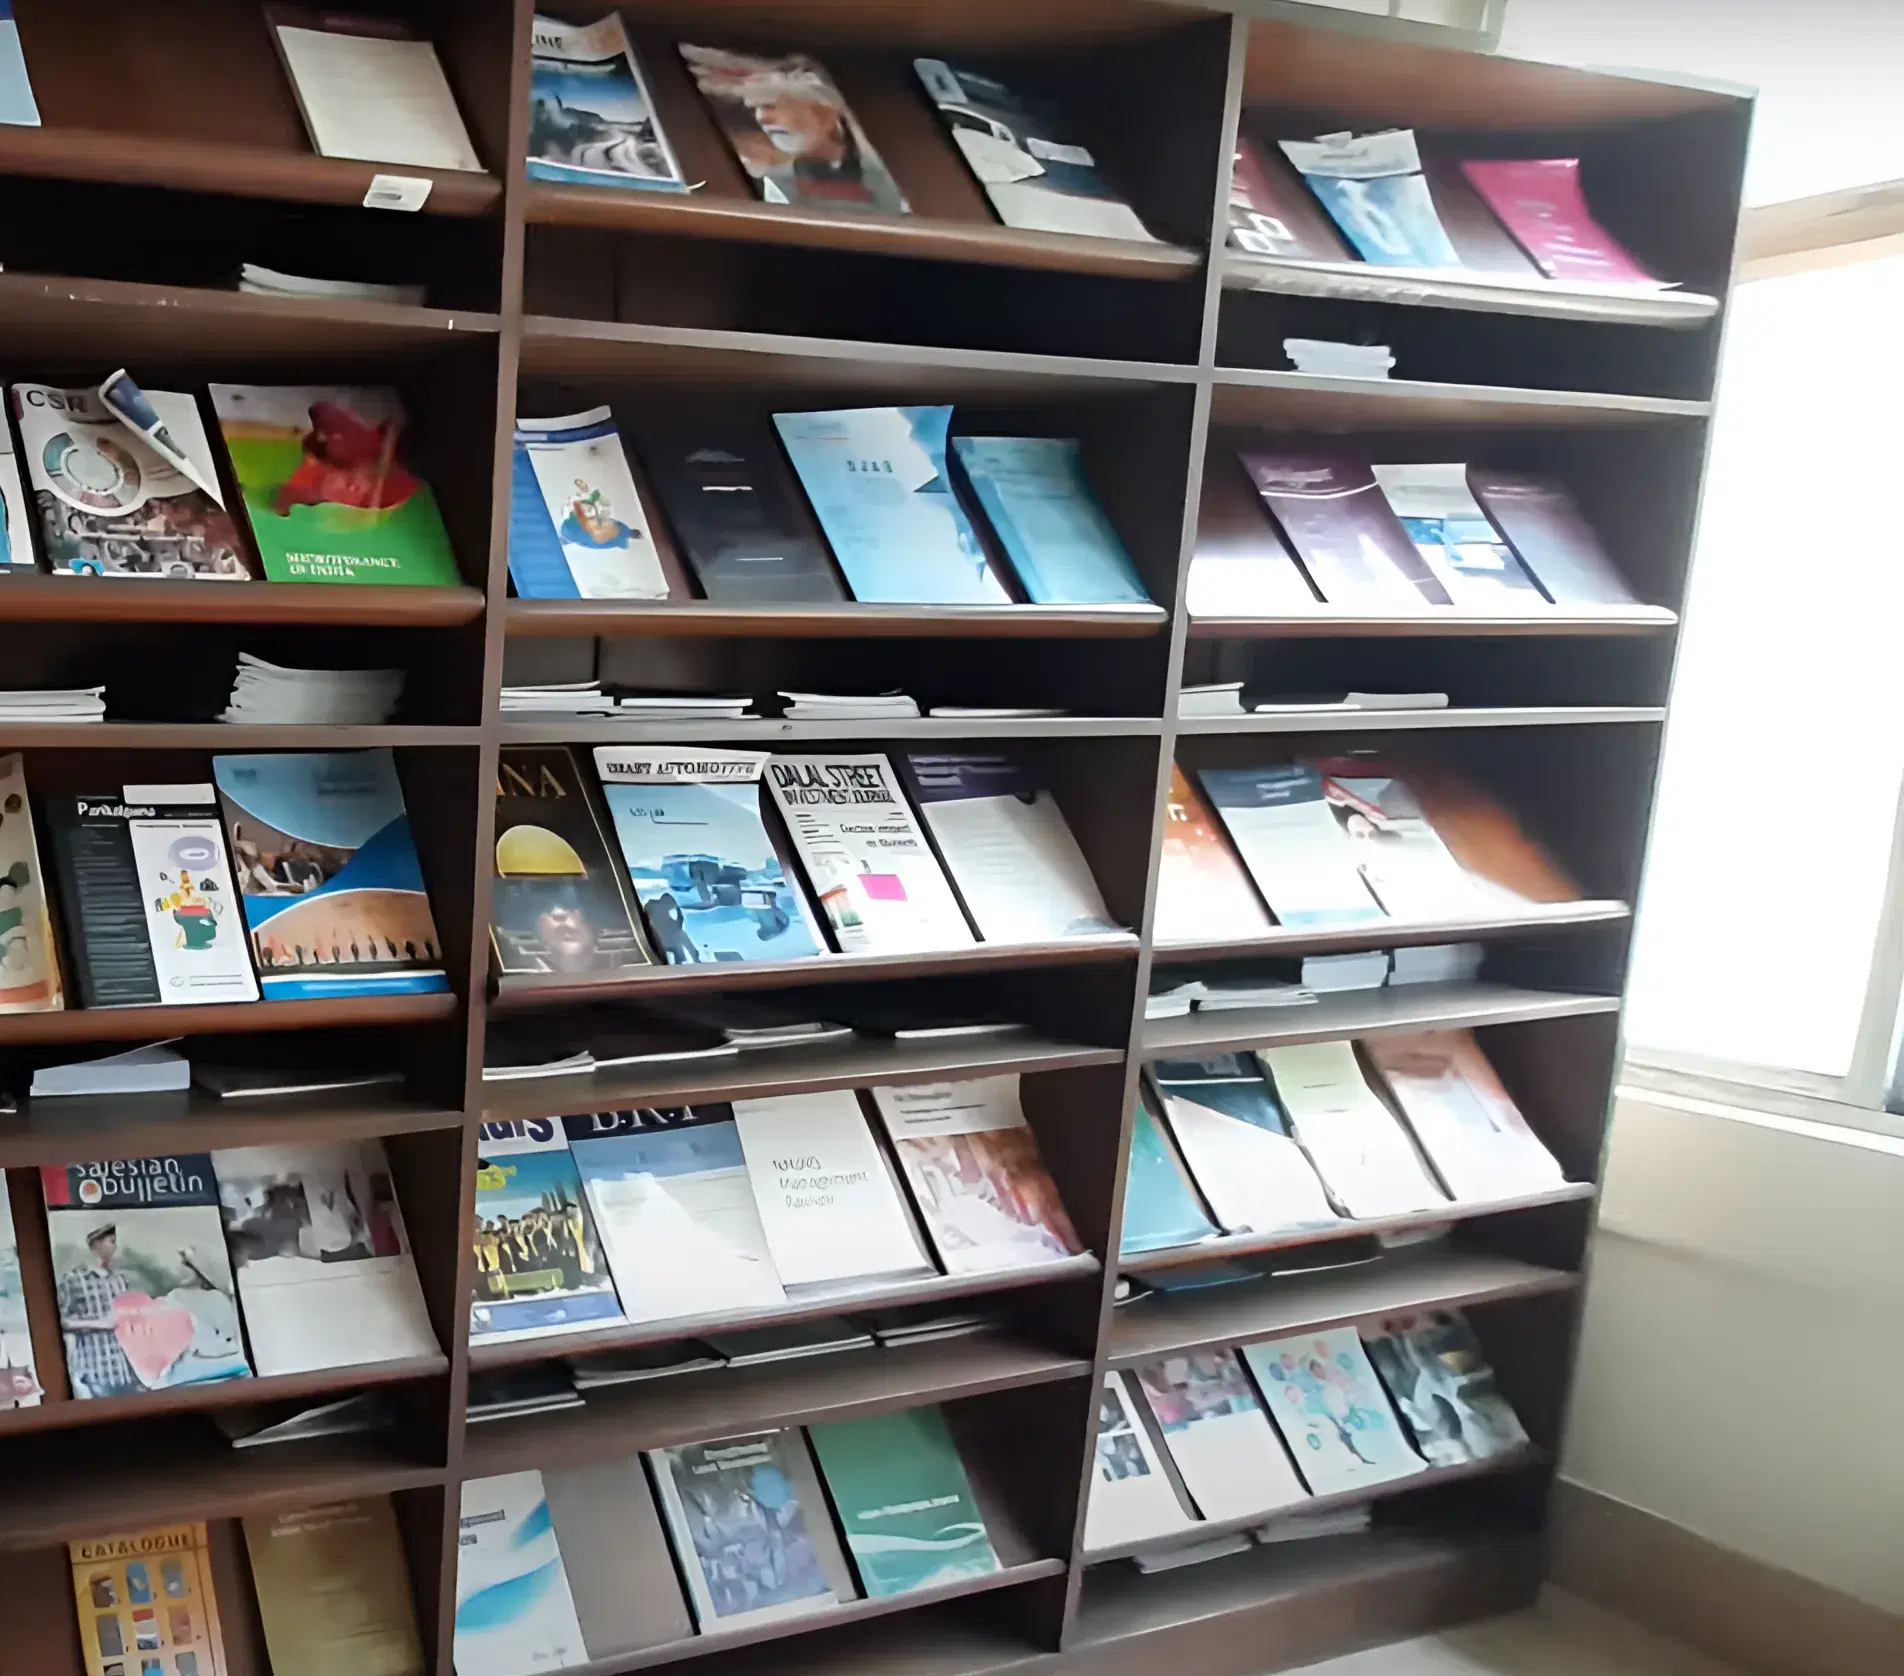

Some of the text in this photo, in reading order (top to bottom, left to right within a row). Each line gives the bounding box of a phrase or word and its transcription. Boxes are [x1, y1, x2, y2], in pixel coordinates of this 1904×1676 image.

[825, 764, 888, 788] STREET
[100, 1172, 205, 1202] bulletin
[81, 1533, 191, 1560] CATALOGUE
